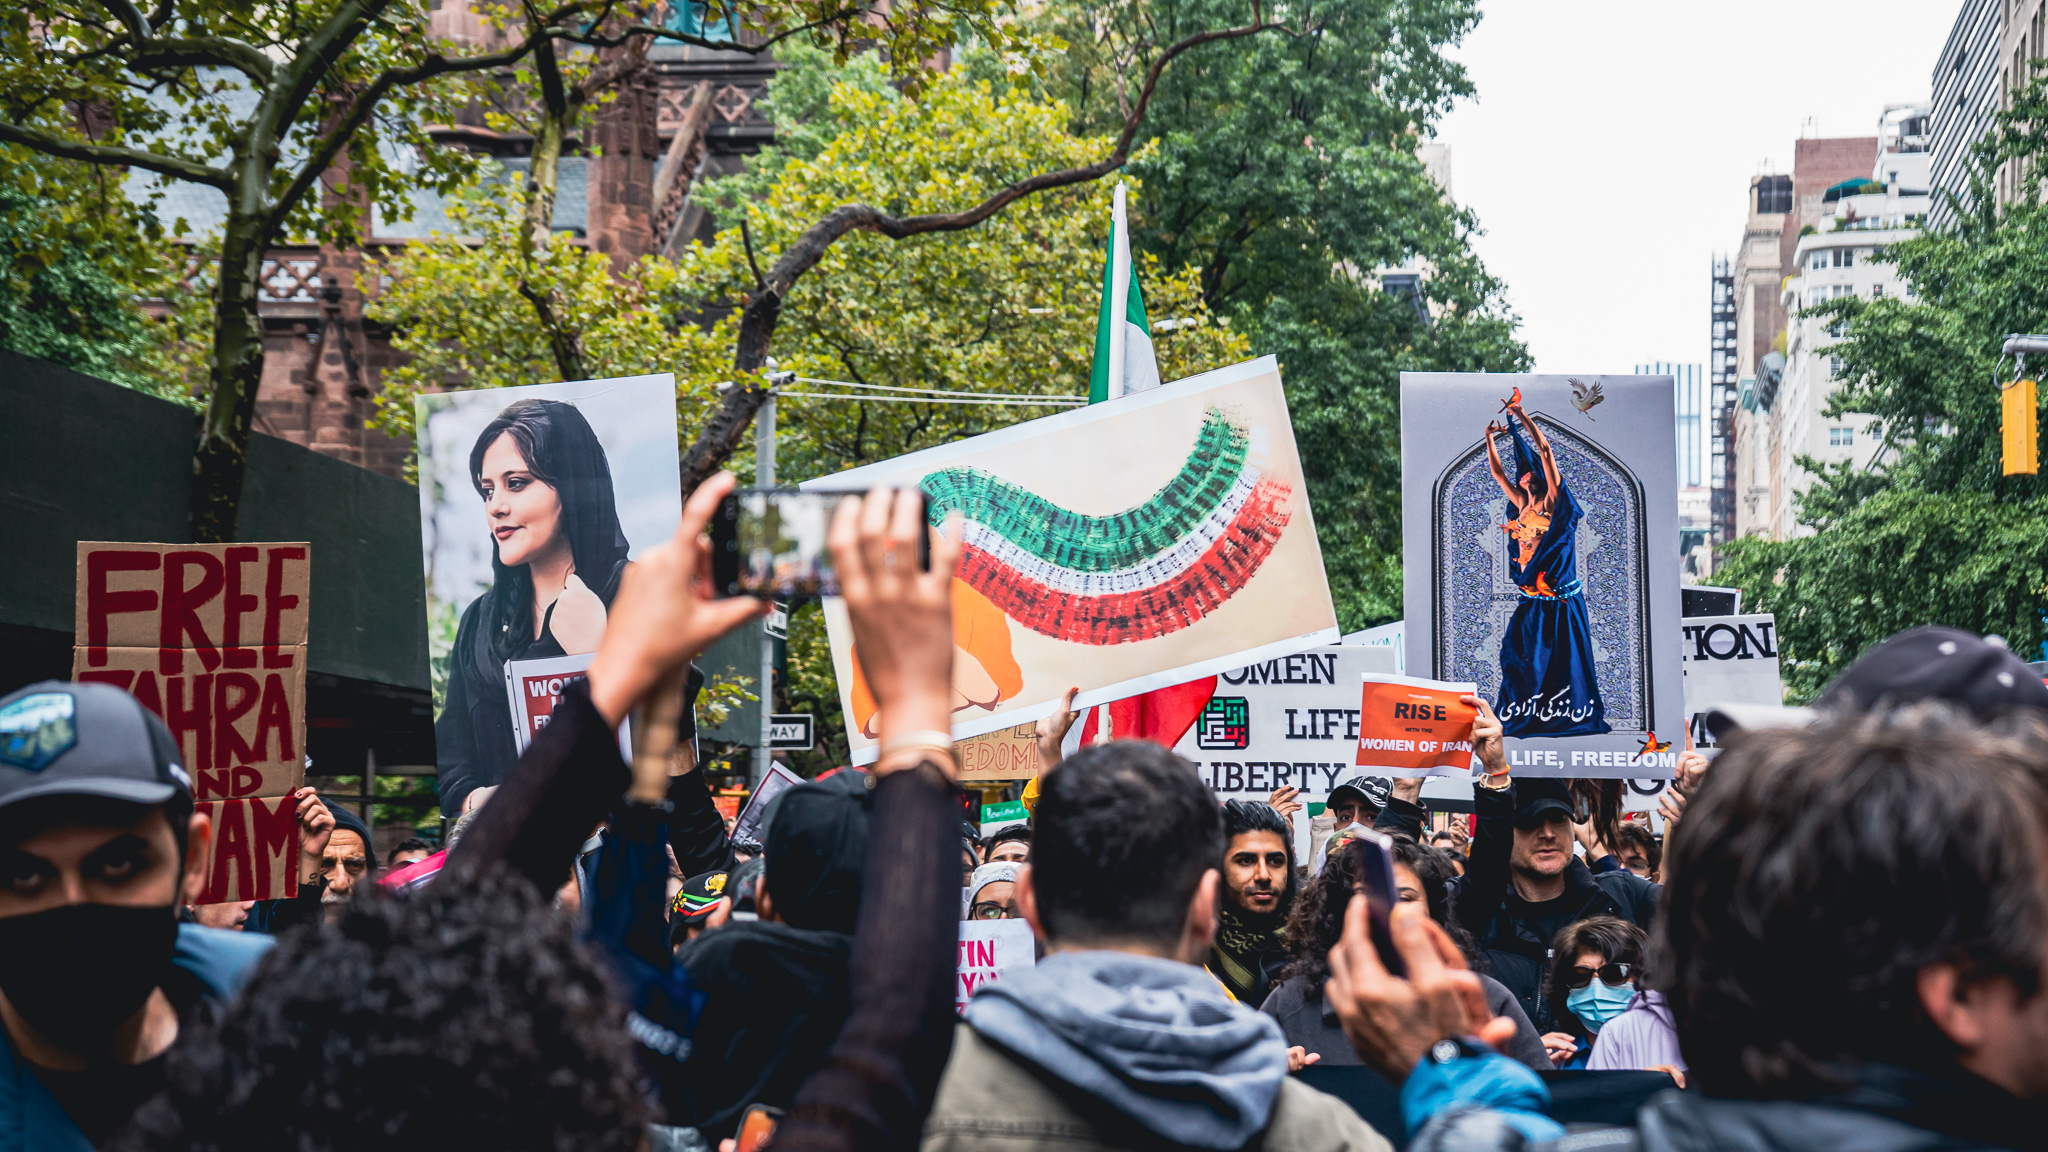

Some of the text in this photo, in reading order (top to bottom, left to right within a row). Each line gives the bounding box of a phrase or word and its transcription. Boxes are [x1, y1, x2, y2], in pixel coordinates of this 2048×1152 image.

[87, 547, 306, 675] FREE
[79, 670, 296, 771] HRA
[1394, 703, 1447, 721] RISE
[1499, 693, 1544, 722] آزادی
[770, 726, 798, 738] WAY
[1285, 708, 1360, 740] LIFE
[953, 741, 1038, 772] EDOM!
[1361, 738, 1473, 753] WOMEN OF IRAN
[1511, 750, 1676, 770] LIFE, FREEDOM
[189, 766, 263, 800] ND
[183, 787, 299, 905] AM
